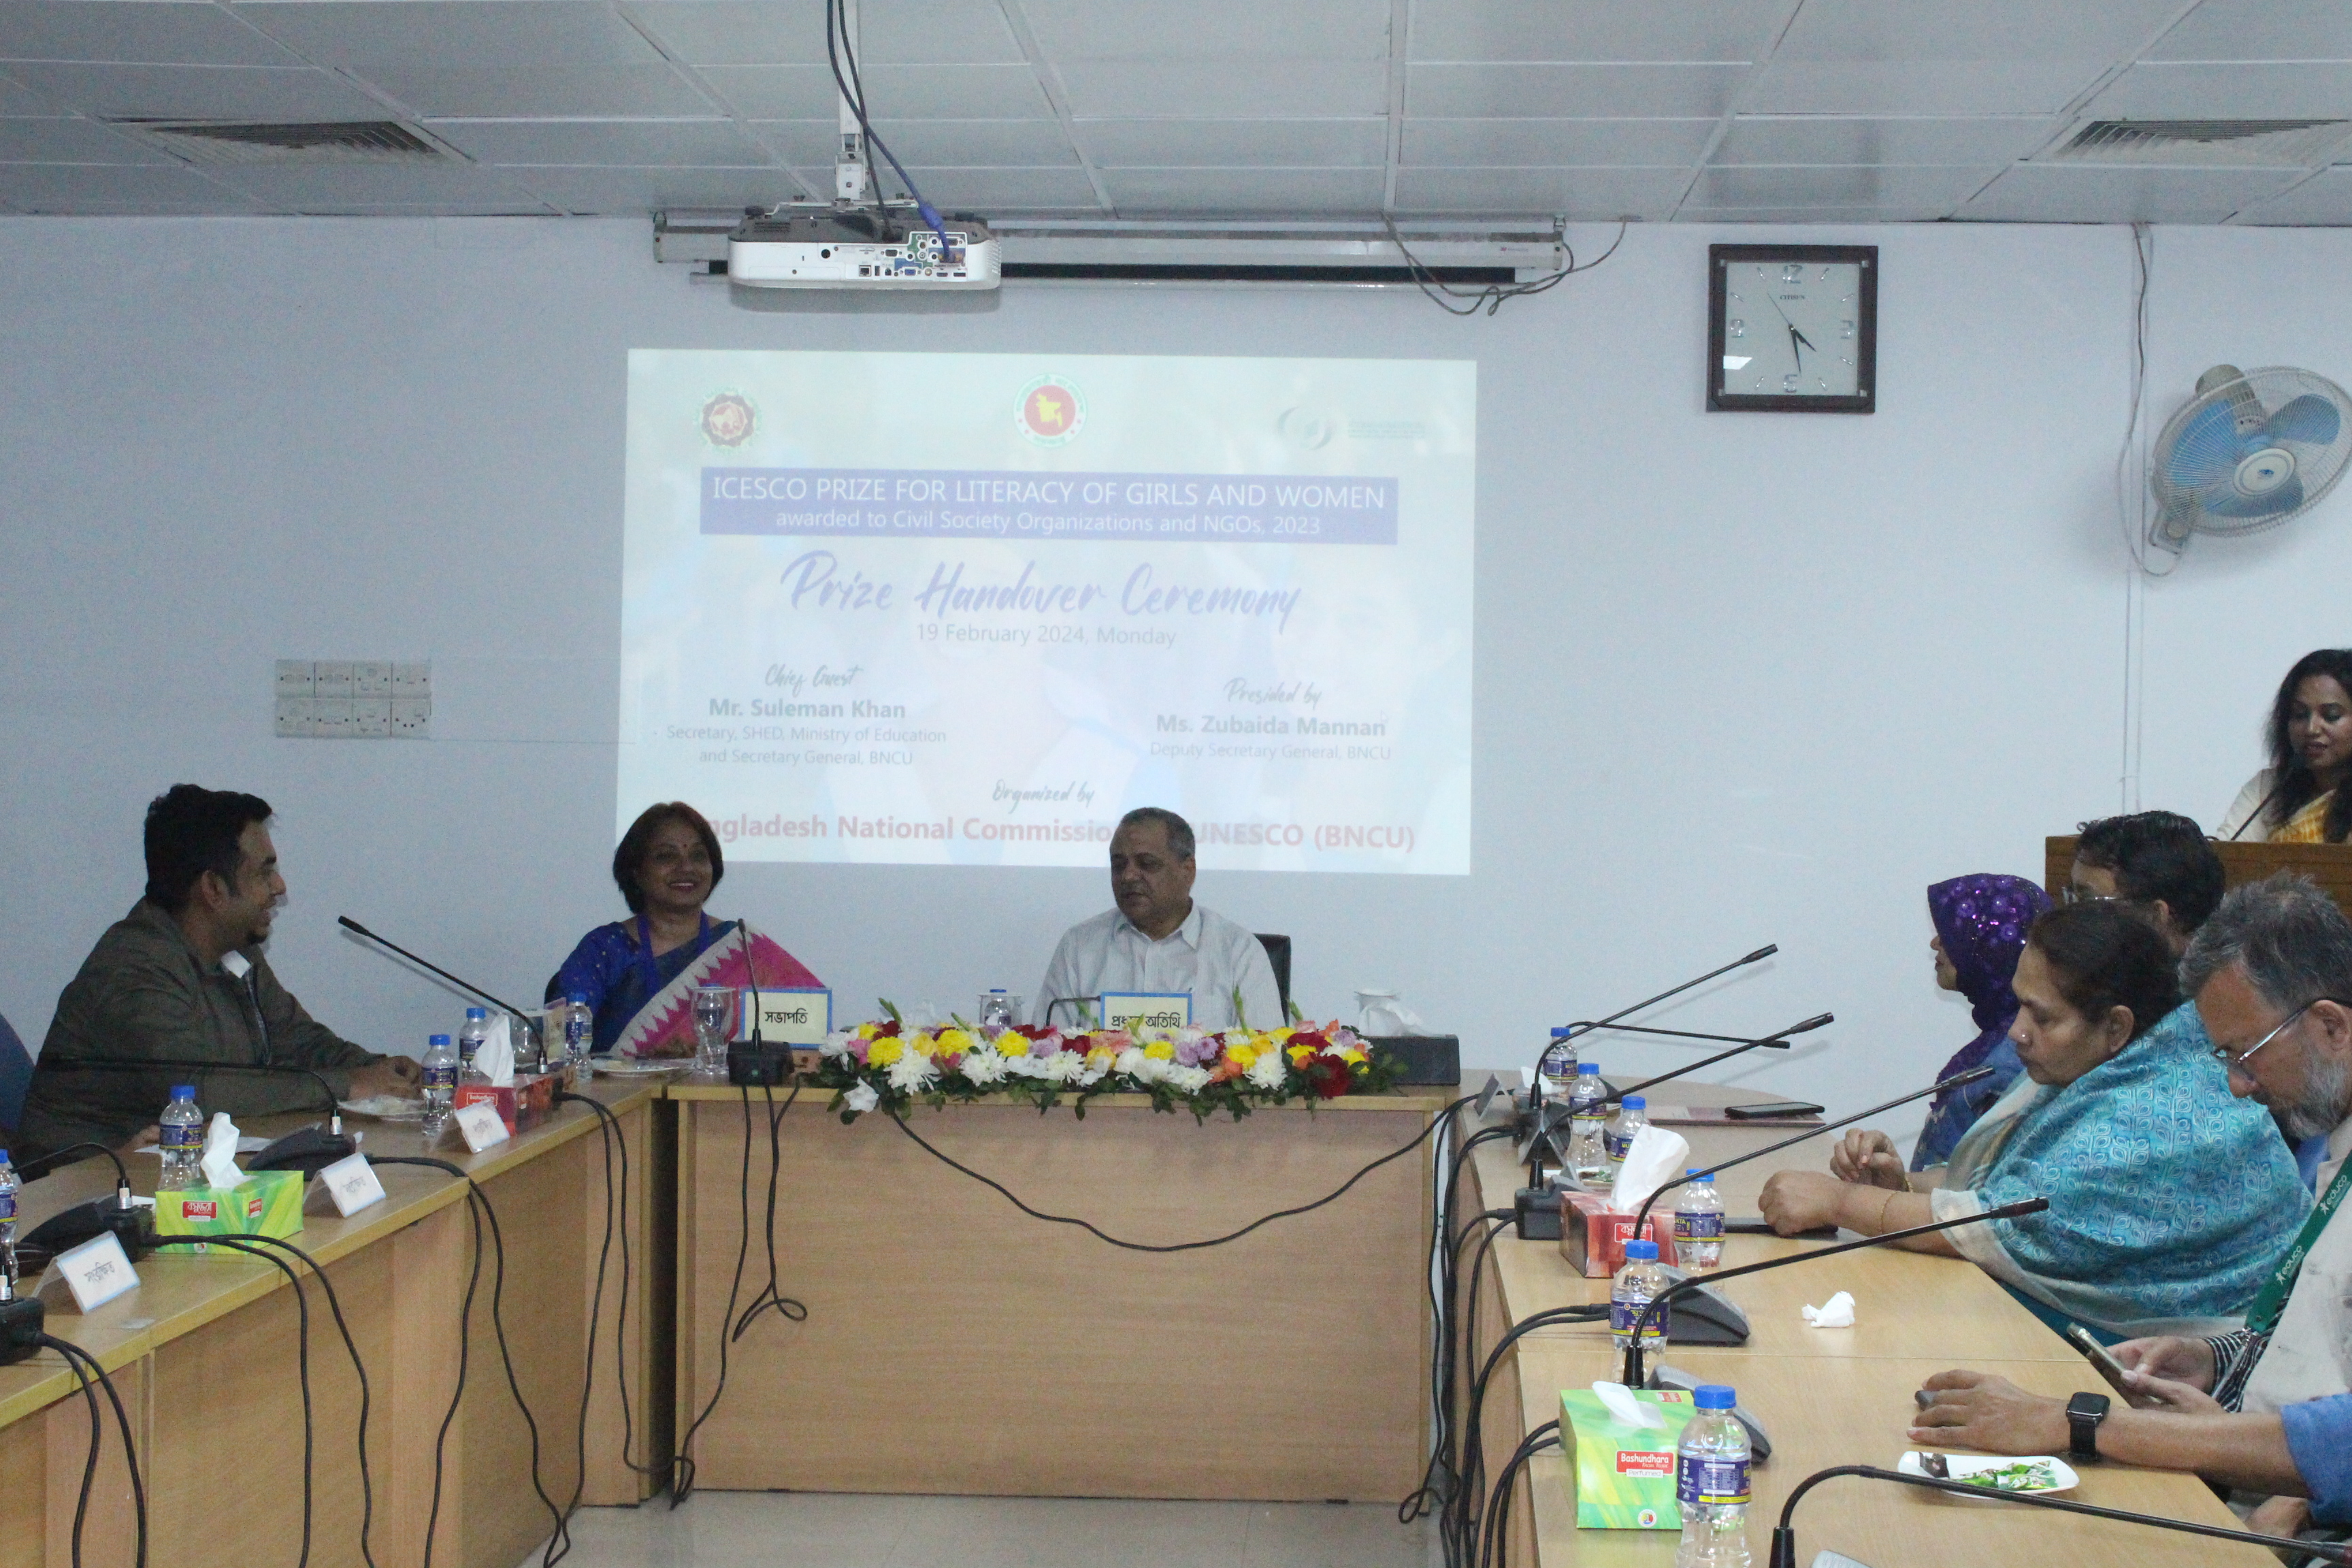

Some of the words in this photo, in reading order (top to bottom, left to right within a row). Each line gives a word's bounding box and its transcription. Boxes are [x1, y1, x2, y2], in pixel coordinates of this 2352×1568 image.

[713, 477, 807, 500] ICESCO
[817, 478, 885, 502] PRIZE
[896, 479, 946, 502] FOR
[957, 480, 1073, 504] LITERACY
[1083, 481, 1117, 504] OF
[1126, 482, 1198, 506] GIRLS
[1207, 483, 1266, 507] AND
[1275, 485, 1384, 508] WOMEN
[776, 510, 860, 527] awarded
[868, 512, 886, 527] to
[894, 510, 933, 528] Civil
[941, 510, 1011, 534] Society
[1017, 512, 1153, 535] Organizations
[1160, 515, 1196, 533] and
[1205, 516, 1266, 536] NGOs,
[1273, 517, 1320, 534] 2023
[780, 550, 894, 610] Prize
[915, 559, 1107, 619] Handover
[1121, 562, 1301, 634] Ceremony
[917, 624, 938, 640] 19
[946, 623, 1030, 646] February
[1037, 625, 1088, 644] 2024,
[1097, 626, 1176, 649] Monday
[765, 664, 806, 698] Chief
[813, 664, 864, 686] Guest
[1224, 677, 1301, 705] Presided
[1304, 683, 1322, 710] by
[708, 698, 743, 717] Mr.
[751, 698, 843, 718] Suleman
[852, 700, 906, 719] Khan
[667, 725, 737, 742] Secretary,
[742, 727, 785, 742] SHED,
[791, 727, 850, 745] Ministry
[854, 726, 870, 741] of
[875, 728, 947, 743] Education
[1156, 715, 1194, 733] Ms.
[1201, 715, 1289, 735] Zubaida
[1296, 717, 1386, 736] Mannan
[699, 749, 727, 763] and
[732, 749, 800, 767] Secretary
[804, 750, 864, 766] General,
[870, 751, 913, 765] BNCU
[1150, 742, 1203, 760] Deputy
[1208, 743, 1276, 762] Secretary
[1281, 745, 1342, 762] General,
[1348, 746, 1391, 760] BNCU
[992, 779, 1073, 814] Organized
[1077, 782, 1095, 808] by
[708, 813, 828, 843] ngladesh
[837, 815, 953, 840] National
[962, 818, 1115, 843] Commissio
[1189, 822, 1304, 847] UNESCO
[1313, 825, 1415, 853] (BNCU)
[764, 1007, 808, 1024] সভাপতি
[1145, 1011, 1181, 1028] অতিথি
[2327, 1175, 2347, 1205] educo
[2282, 1245, 2302, 1275] educo
[1621, 1453, 1669, 1463] Bashundhara
